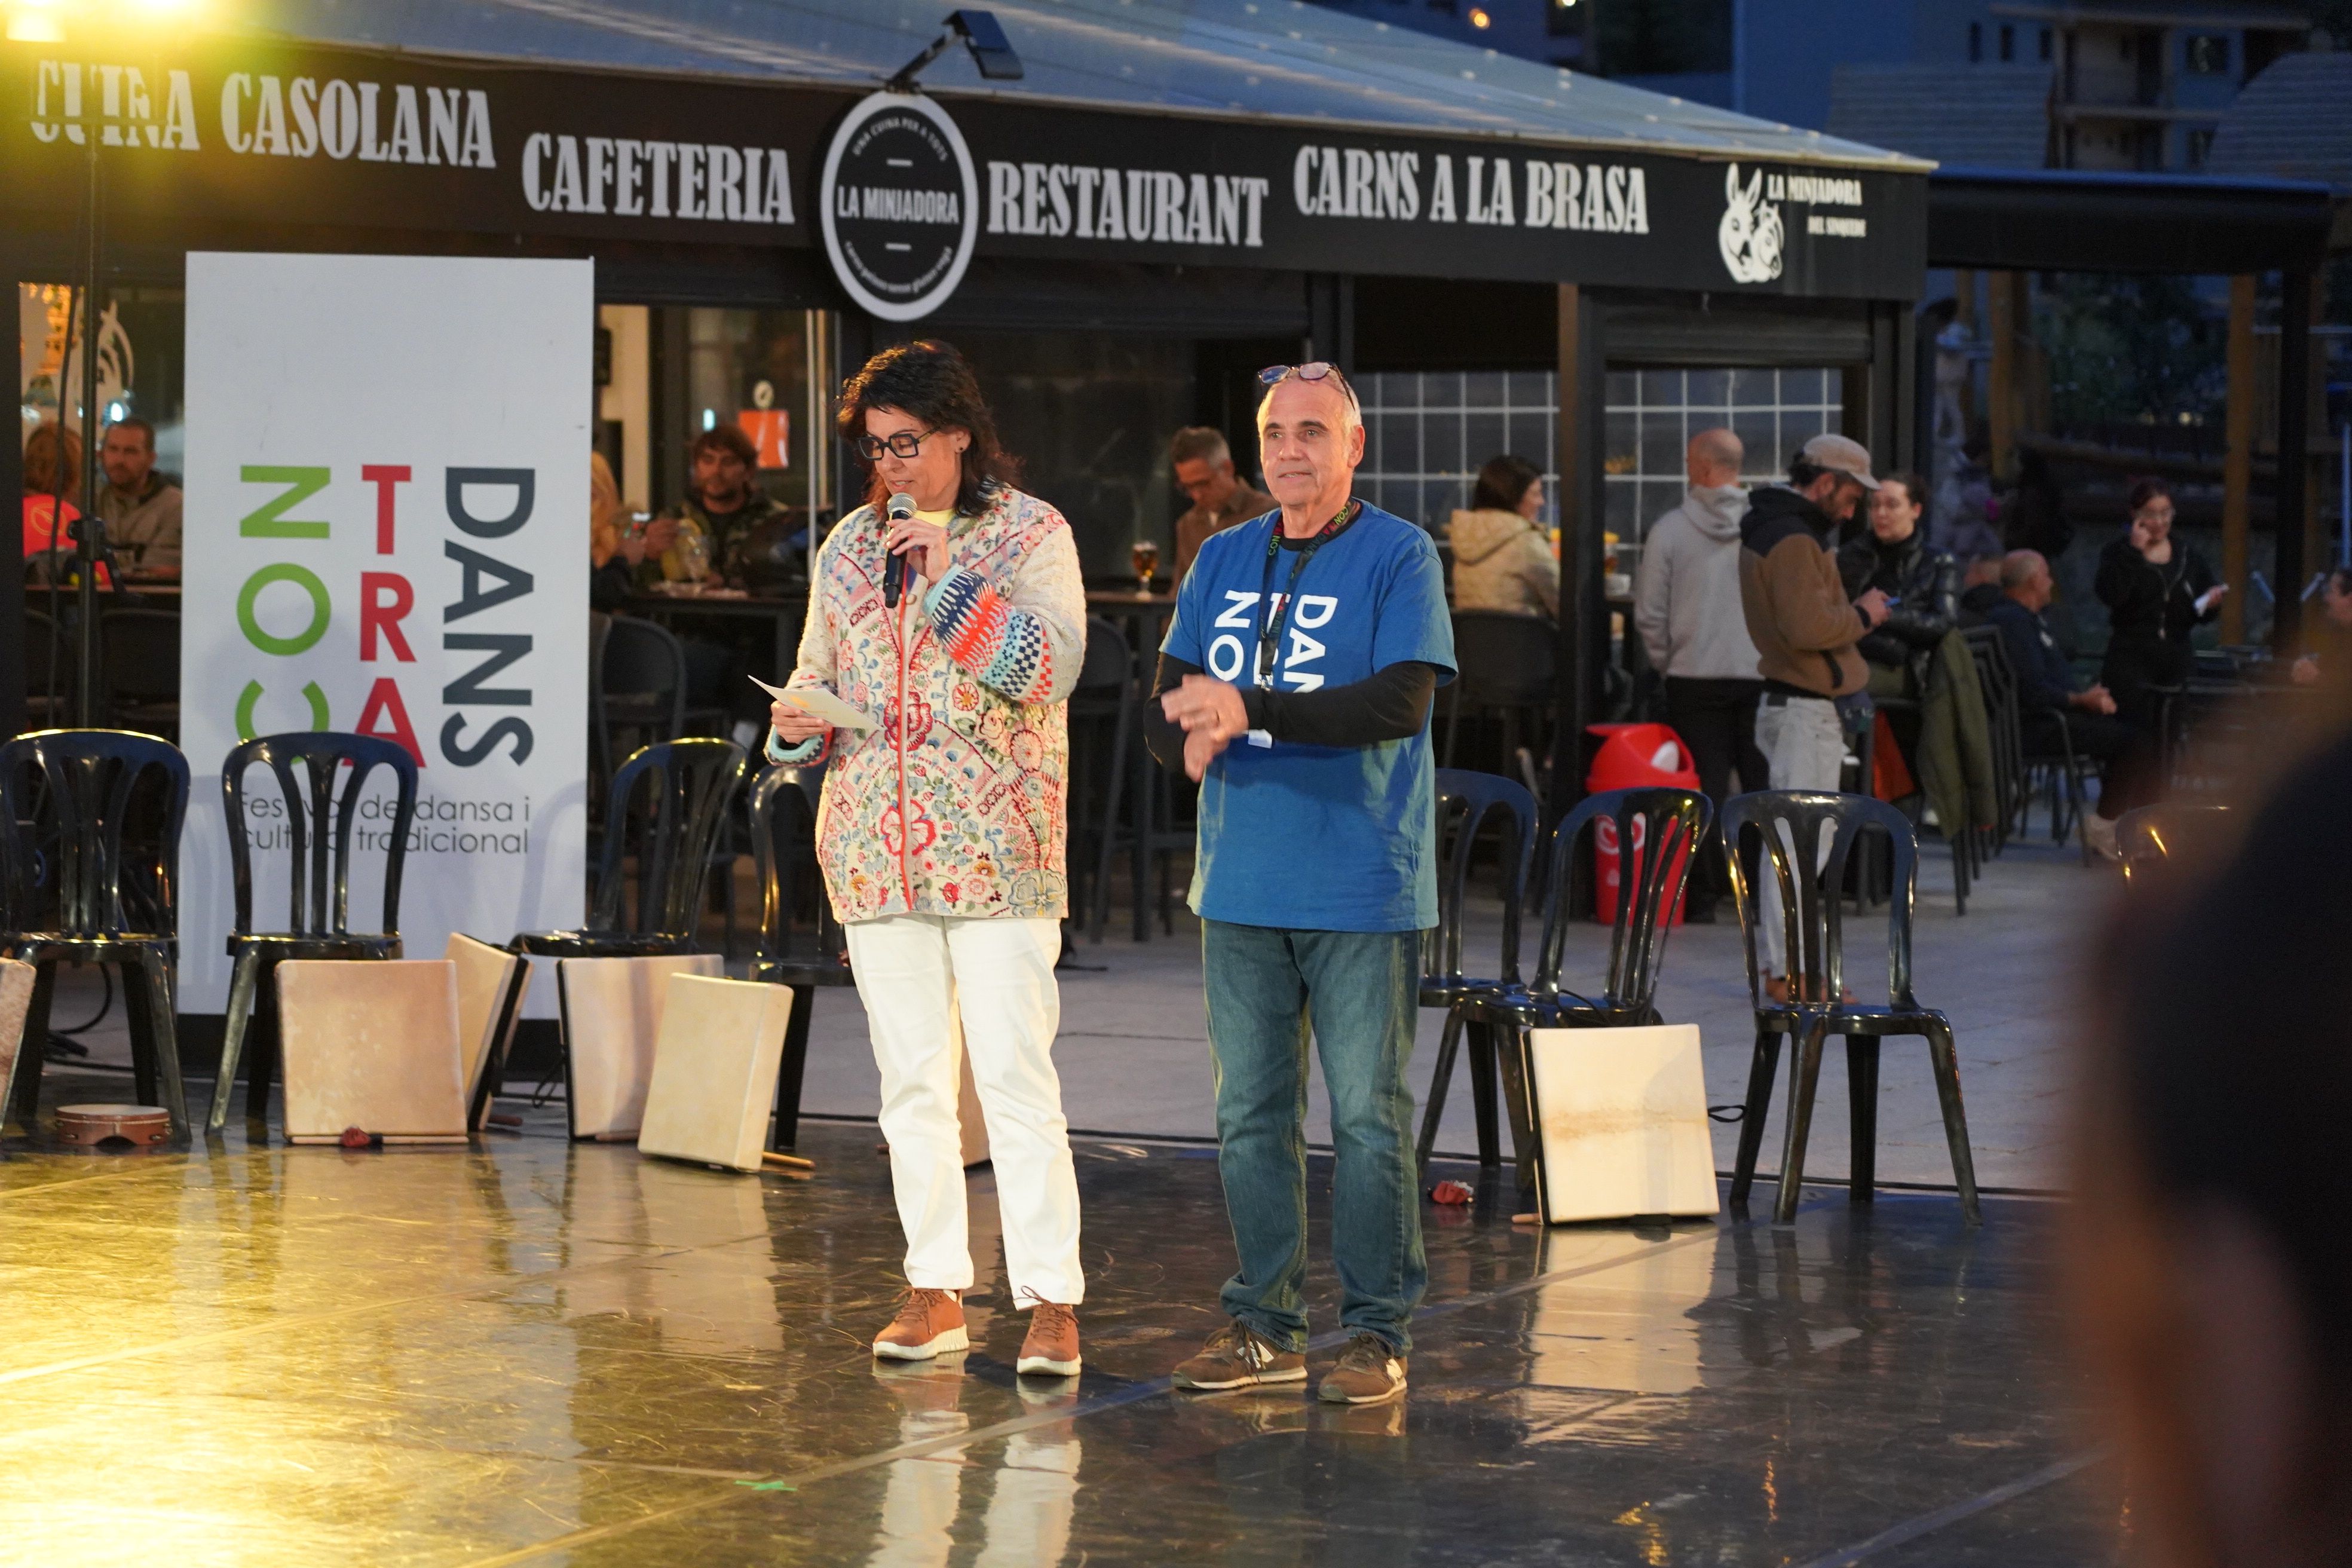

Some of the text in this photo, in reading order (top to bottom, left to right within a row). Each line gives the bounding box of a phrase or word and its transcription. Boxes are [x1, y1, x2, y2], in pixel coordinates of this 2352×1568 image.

[220, 72, 497, 168] CASOLANA
[522, 132, 795, 224] CAFETERIA
[838, 186, 960, 224] LA MINJADORA
[987, 161, 1269, 247] RESTAURANT
[1293, 145, 1649, 234] CARNS A LA BRASA
[1767, 174, 1863, 206] LA MINJADORA
[342, 465, 425, 767] TRA
[440, 467, 535, 767] DANS
[1208, 590, 1261, 682] ON
[1283, 595, 1338, 693] DAN
[415, 795, 513, 822] dansa
[525, 796, 529, 822] i
